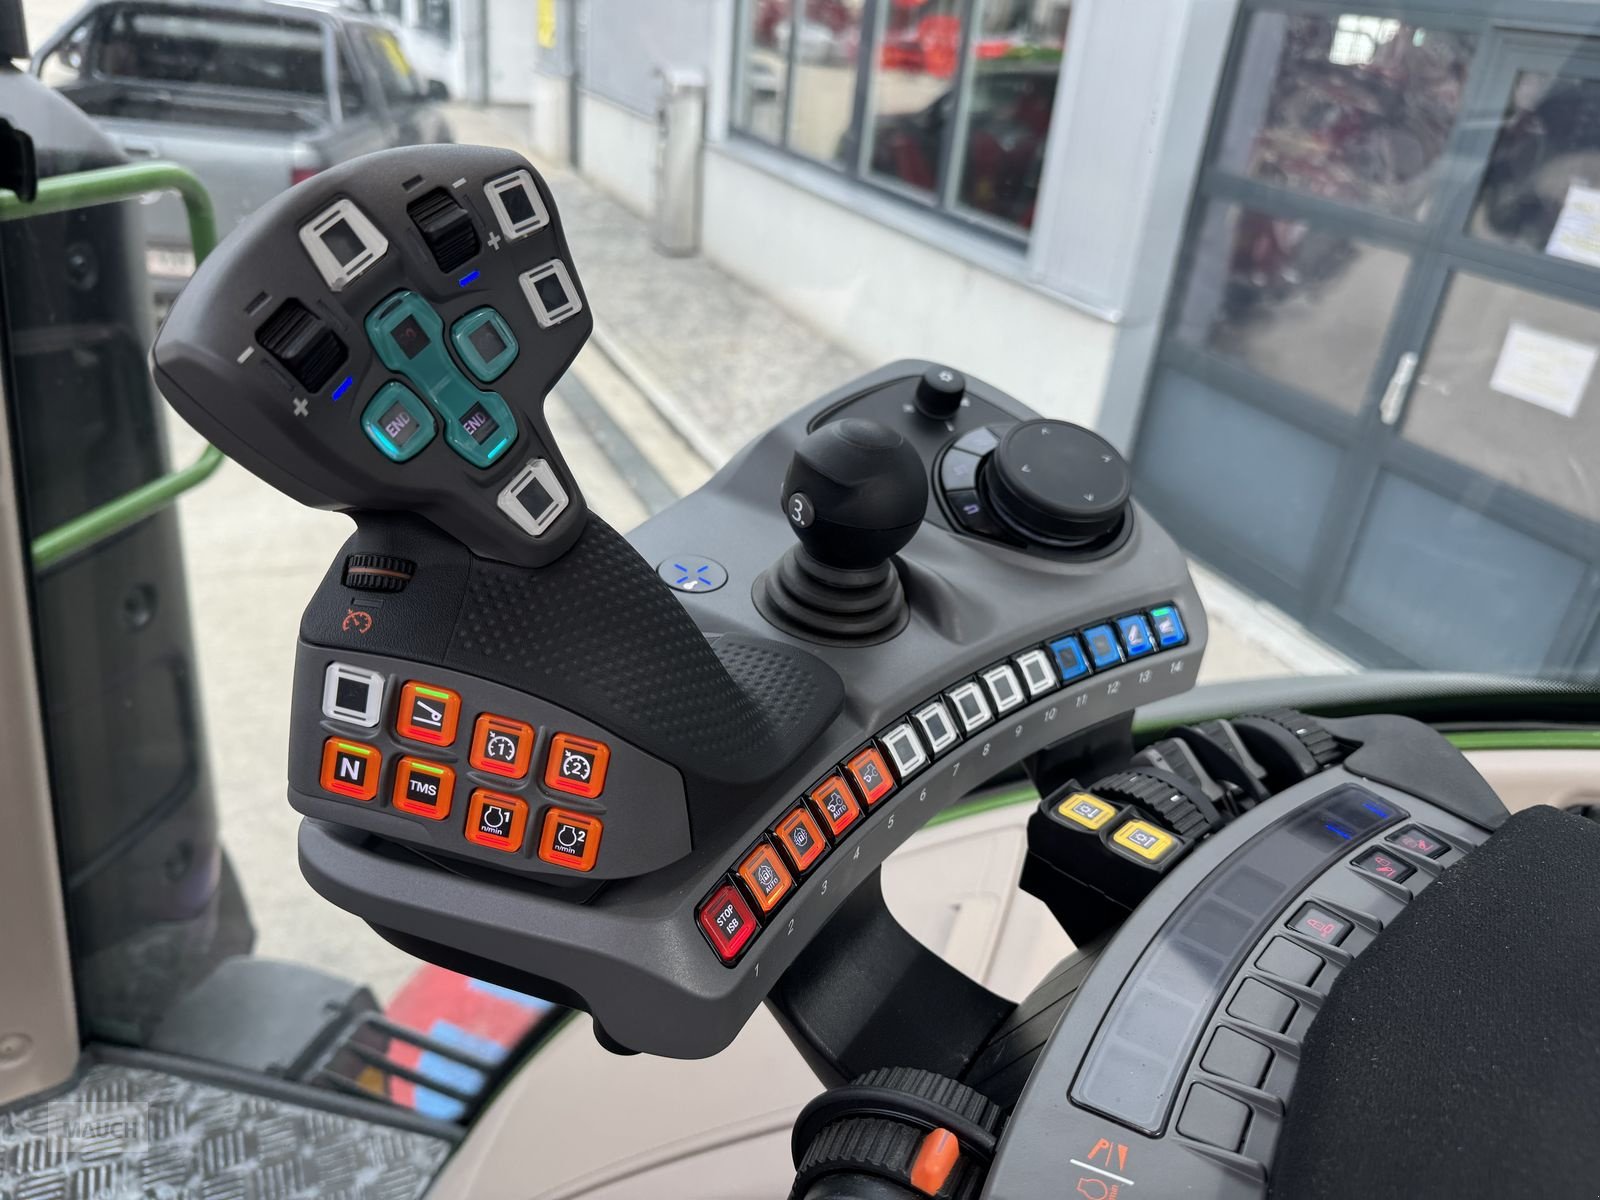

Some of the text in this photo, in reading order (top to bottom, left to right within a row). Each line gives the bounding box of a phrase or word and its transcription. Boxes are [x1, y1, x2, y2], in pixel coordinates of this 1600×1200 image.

[385, 412, 410, 438] END
[463, 412, 486, 435] END
[1170, 661, 1184, 673] 14
[1138, 670, 1151, 683] 13
[1107, 681, 1120, 694] 12
[1076, 694, 1088, 707] 11
[1044, 708, 1057, 722] 10
[1015, 725, 1023, 737] 9
[498, 744, 504, 755] 1
[982, 743, 991, 756] 8
[340, 758, 360, 780] N
[573, 763, 581, 775] 2
[953, 763, 960, 776] 7
[410, 780, 437, 796] TMS
[919, 788, 927, 801] 6
[504, 812, 510, 822] 1
[833, 805, 847, 820] AUTO
[887, 814, 895, 829] 5
[481, 825, 503, 836] n/min
[577, 831, 586, 842] 2
[554, 844, 576, 855] n/min
[853, 846, 860, 860] 4
[766, 878, 778, 893] AUTO
[821, 880, 828, 895] 3
[717, 904, 734, 926] STOP
[726, 918, 739, 935] ISB
[787, 918, 795, 936] 2
[754, 963, 760, 977] 1
